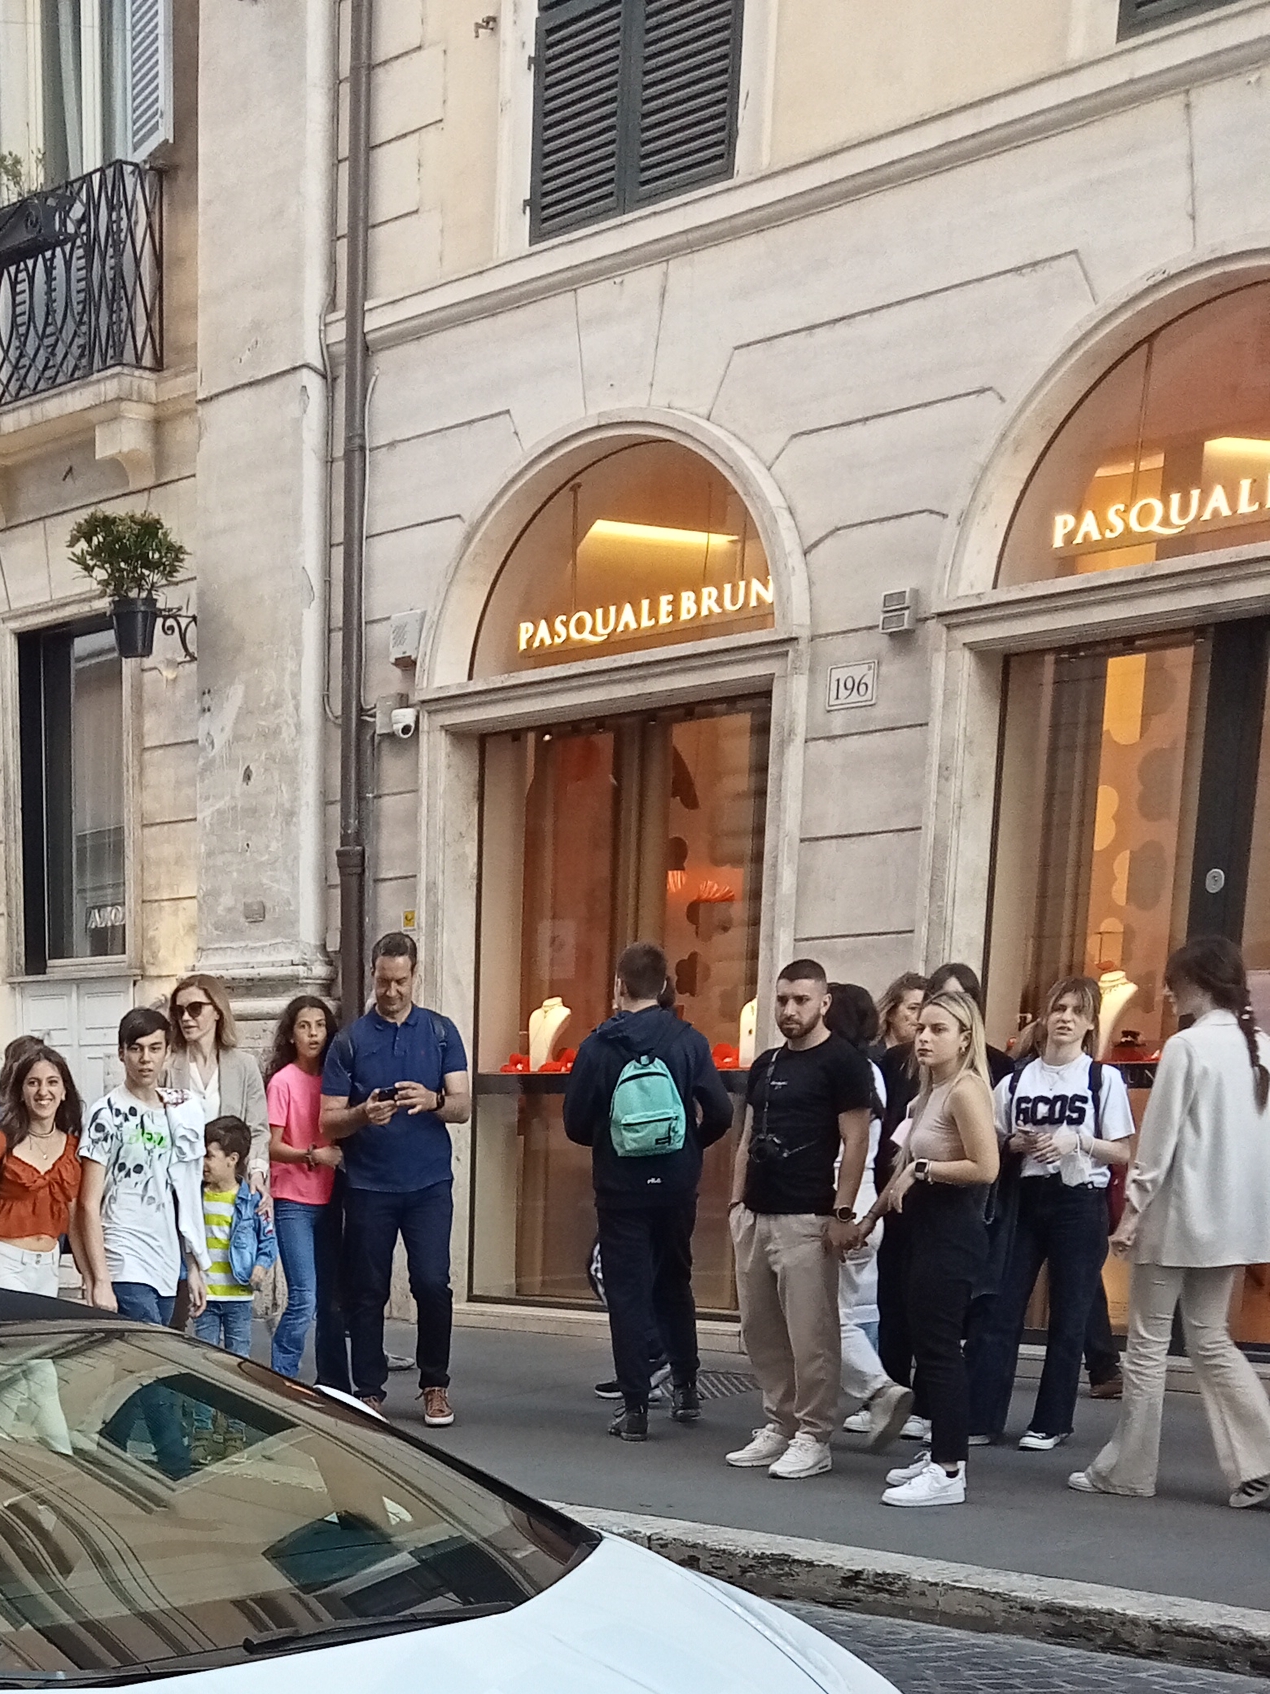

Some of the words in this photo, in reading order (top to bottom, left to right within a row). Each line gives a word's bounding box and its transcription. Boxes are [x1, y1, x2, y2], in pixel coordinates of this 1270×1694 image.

[1052, 473, 1270, 549] PASQUAL
[517, 594, 674, 651] PASQUALE
[834, 673, 869, 701] 196
